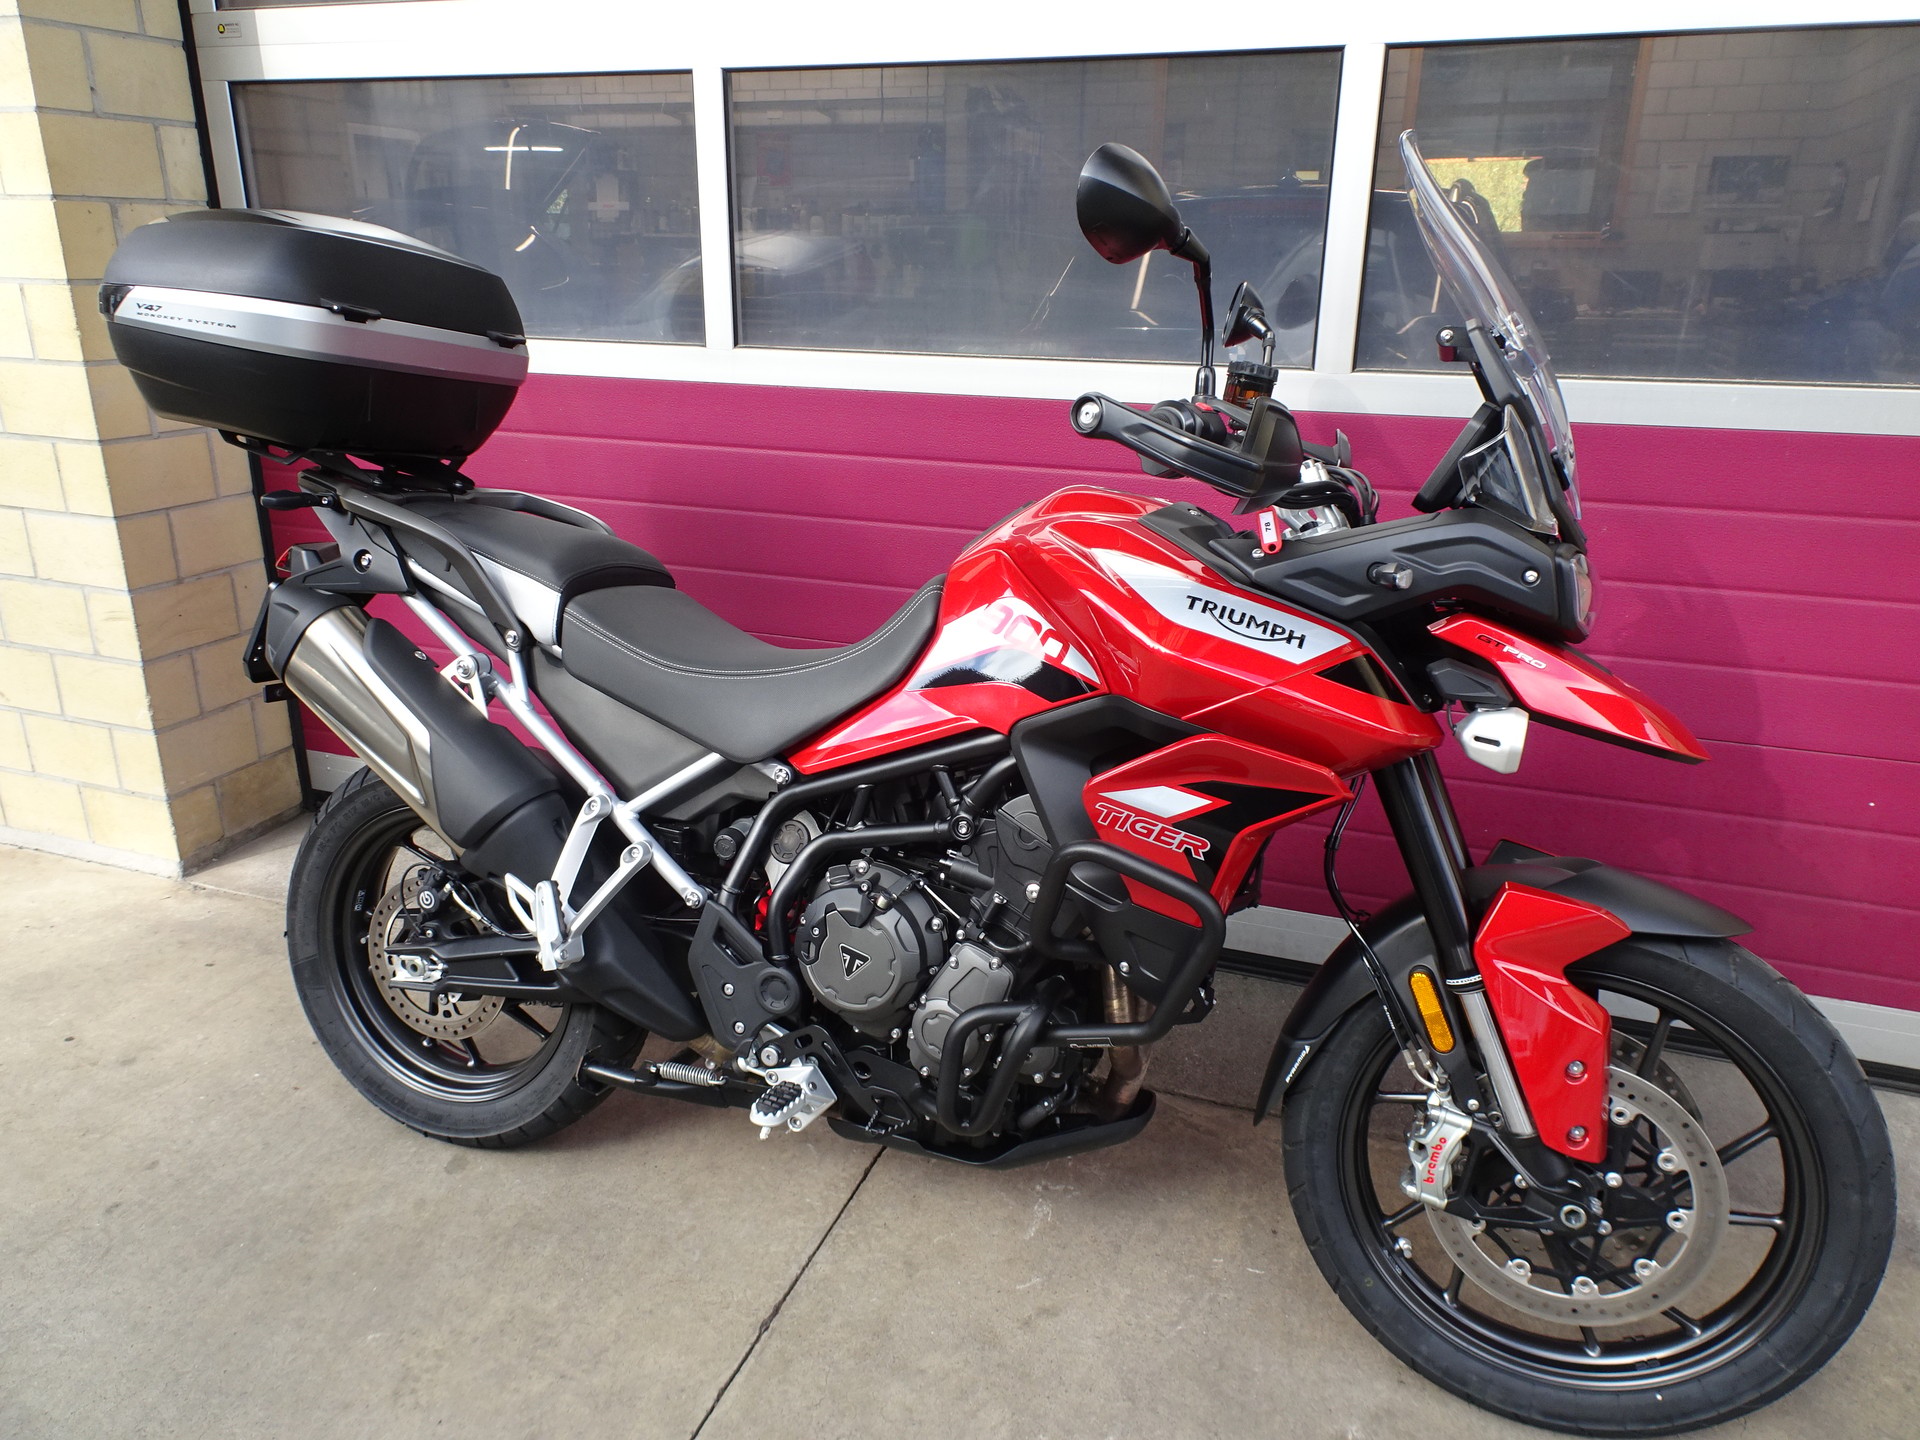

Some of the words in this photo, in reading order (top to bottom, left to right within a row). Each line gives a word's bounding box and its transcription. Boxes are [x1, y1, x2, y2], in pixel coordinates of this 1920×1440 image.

[136, 302, 162, 312] V47
[136, 312, 184, 321] MONOKEY
[187, 318, 237, 329] SYSTEM
[1186, 595, 1306, 650] TRIUMPH
[1095, 802, 1211, 861] TIGER
[1423, 1137, 1448, 1184] brembo
